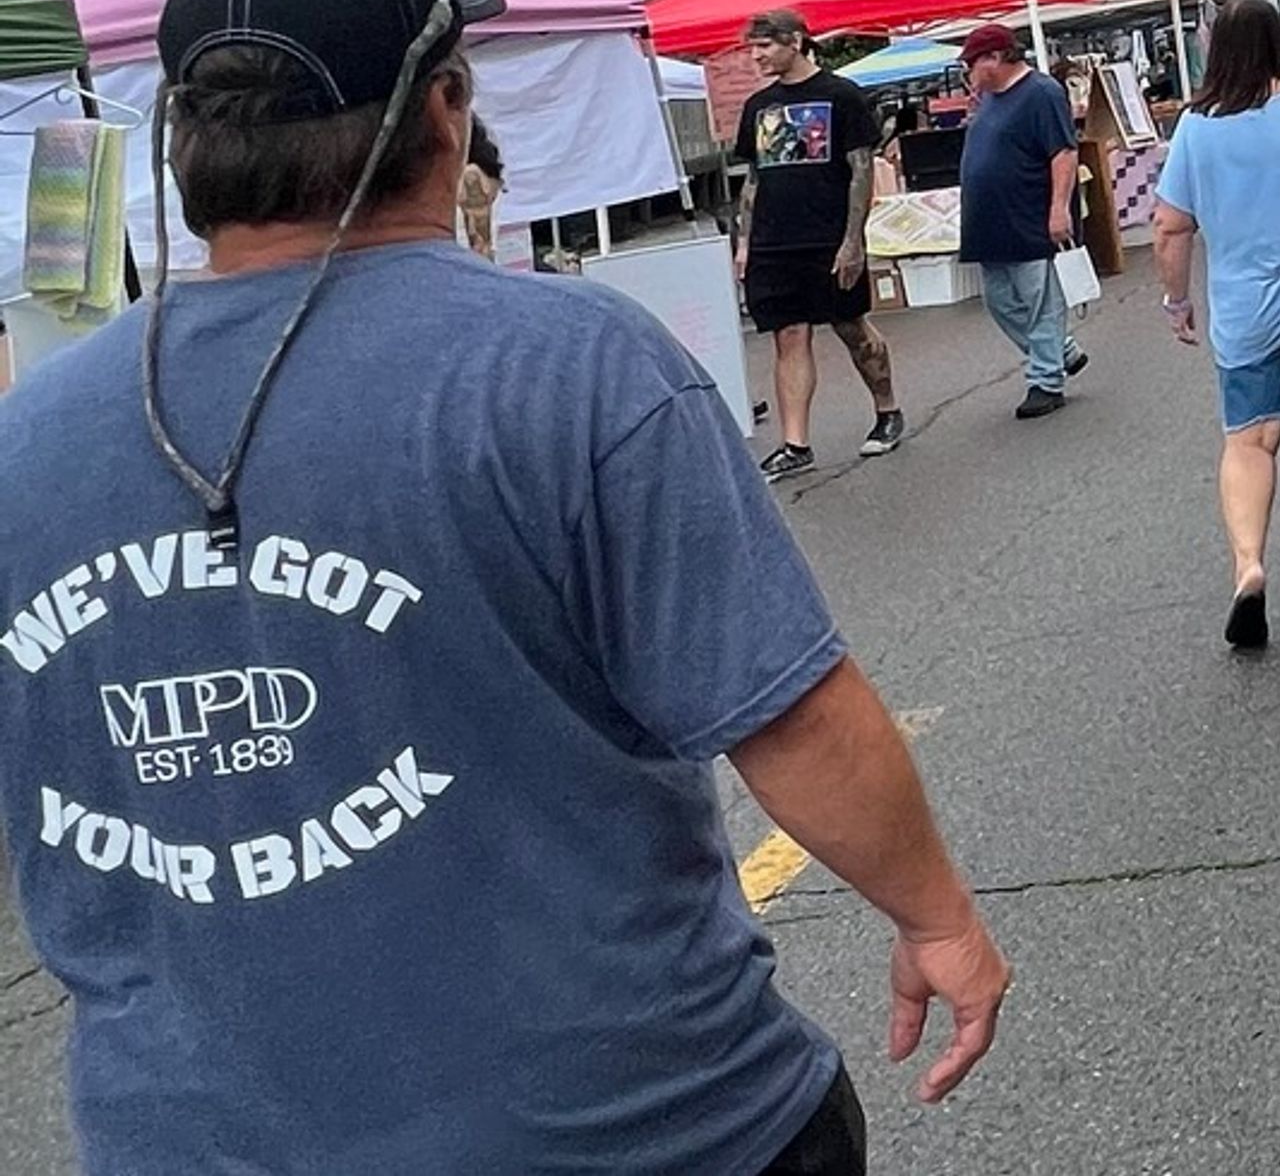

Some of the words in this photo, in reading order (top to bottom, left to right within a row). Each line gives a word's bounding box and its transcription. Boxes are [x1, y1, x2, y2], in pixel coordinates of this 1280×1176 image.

[0, 530, 238, 673] WE'VE
[249, 535, 423, 633] GOT
[100, 667, 318, 747] MPD
[40, 787, 215, 903] YOUR
[230, 746, 455, 900] BACK
